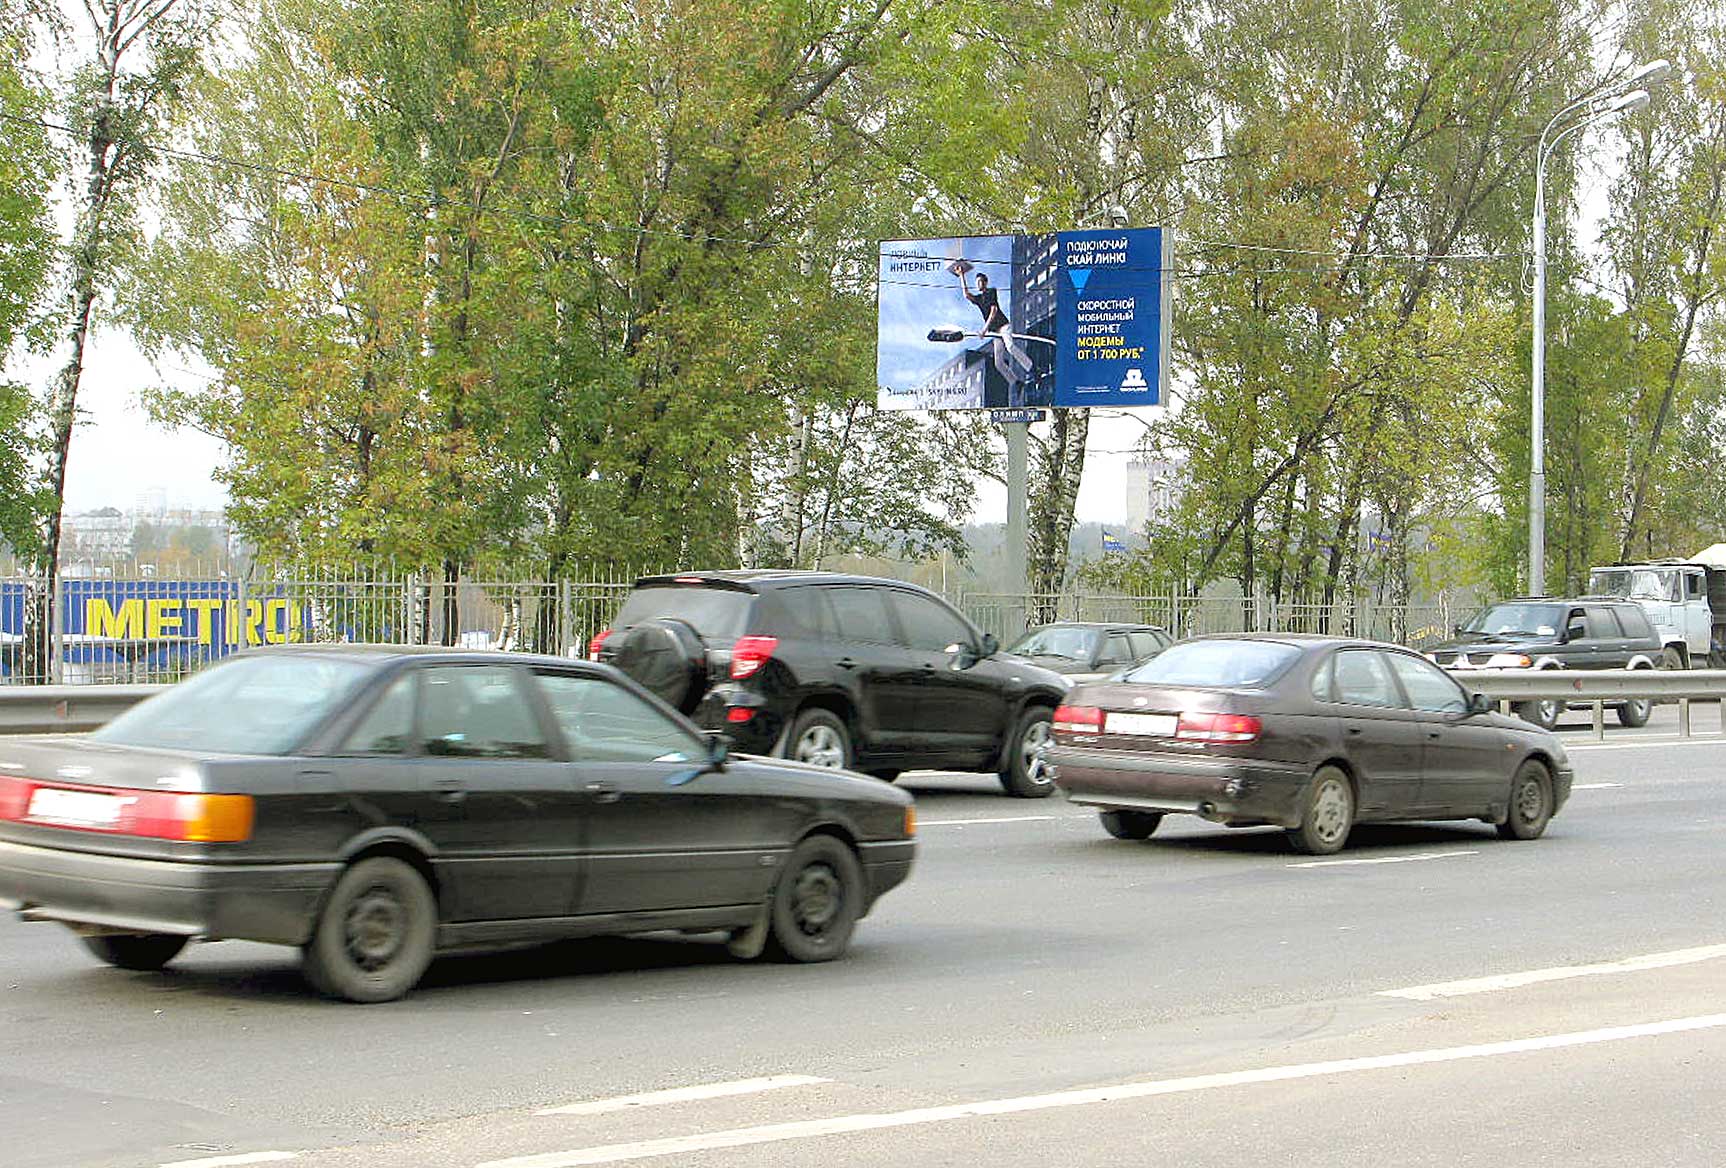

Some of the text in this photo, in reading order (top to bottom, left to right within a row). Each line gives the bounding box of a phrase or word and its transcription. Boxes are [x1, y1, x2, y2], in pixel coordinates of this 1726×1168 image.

[1066, 237, 1128, 252] ПОДКЛЮЧАЙ
[1066, 252, 1093, 265] СКАЙ
[890, 261, 941, 272] ИНТЕРНЕТ?
[1077, 297, 1135, 311] СКОРОСТНОЙ
[1077, 310, 1134, 322] МОБИЛЬНЫЙ
[1077, 323, 1121, 335] ИНТЕРНЕТ
[1077, 336, 1124, 348] МОДЕМЫ
[1077, 349, 1091, 360] ОТ
[86, 598, 301, 645] METRO
